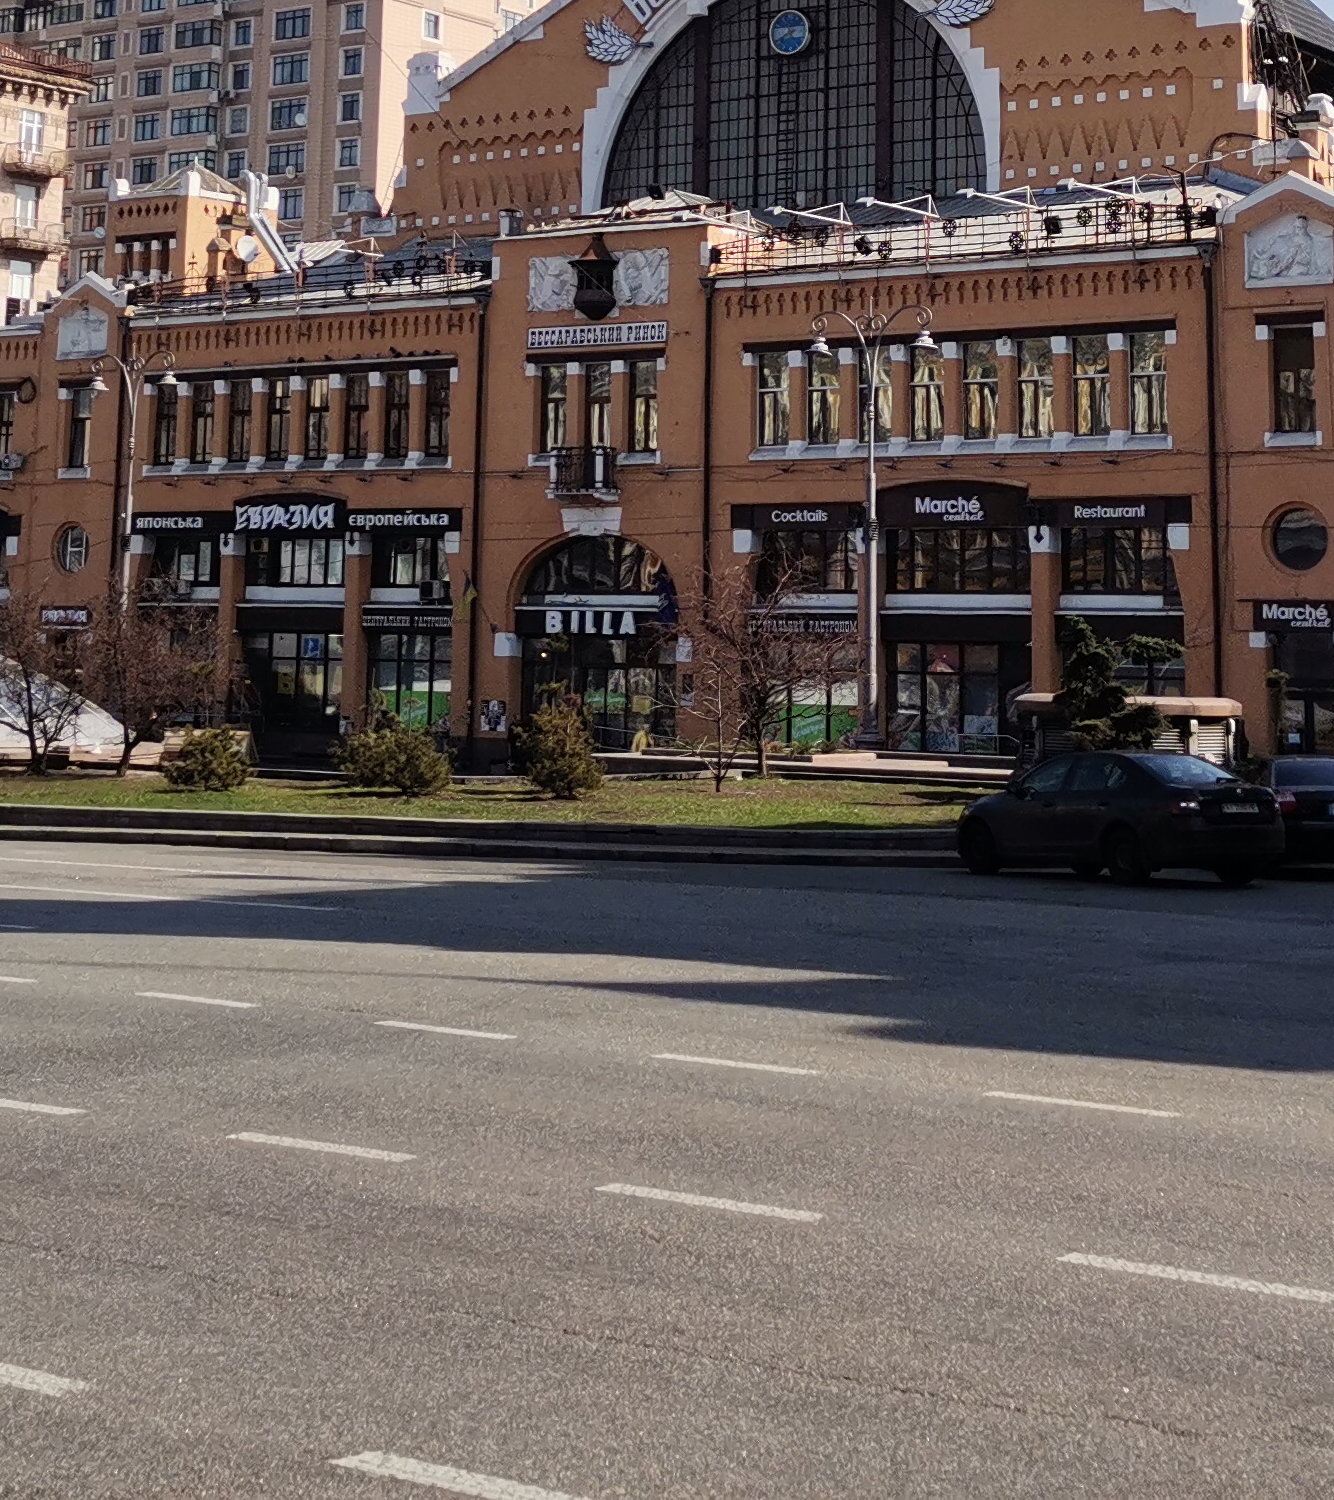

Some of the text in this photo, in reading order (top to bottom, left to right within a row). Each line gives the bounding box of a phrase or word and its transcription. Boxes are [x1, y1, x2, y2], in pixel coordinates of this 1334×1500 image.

[627, 324, 665, 341] РИНОК
[915, 496, 981, 514] Marché
[1073, 504, 1147, 519] Restaurant
[136, 516, 203, 529] японська
[349, 510, 450, 531] європейська
[771, 509, 829, 523] Cocktails
[943, 511, 985, 521] central
[1263, 602, 1329, 621] Marché
[545, 610, 637, 635] BILLA
[1291, 616, 1332, 628] central
